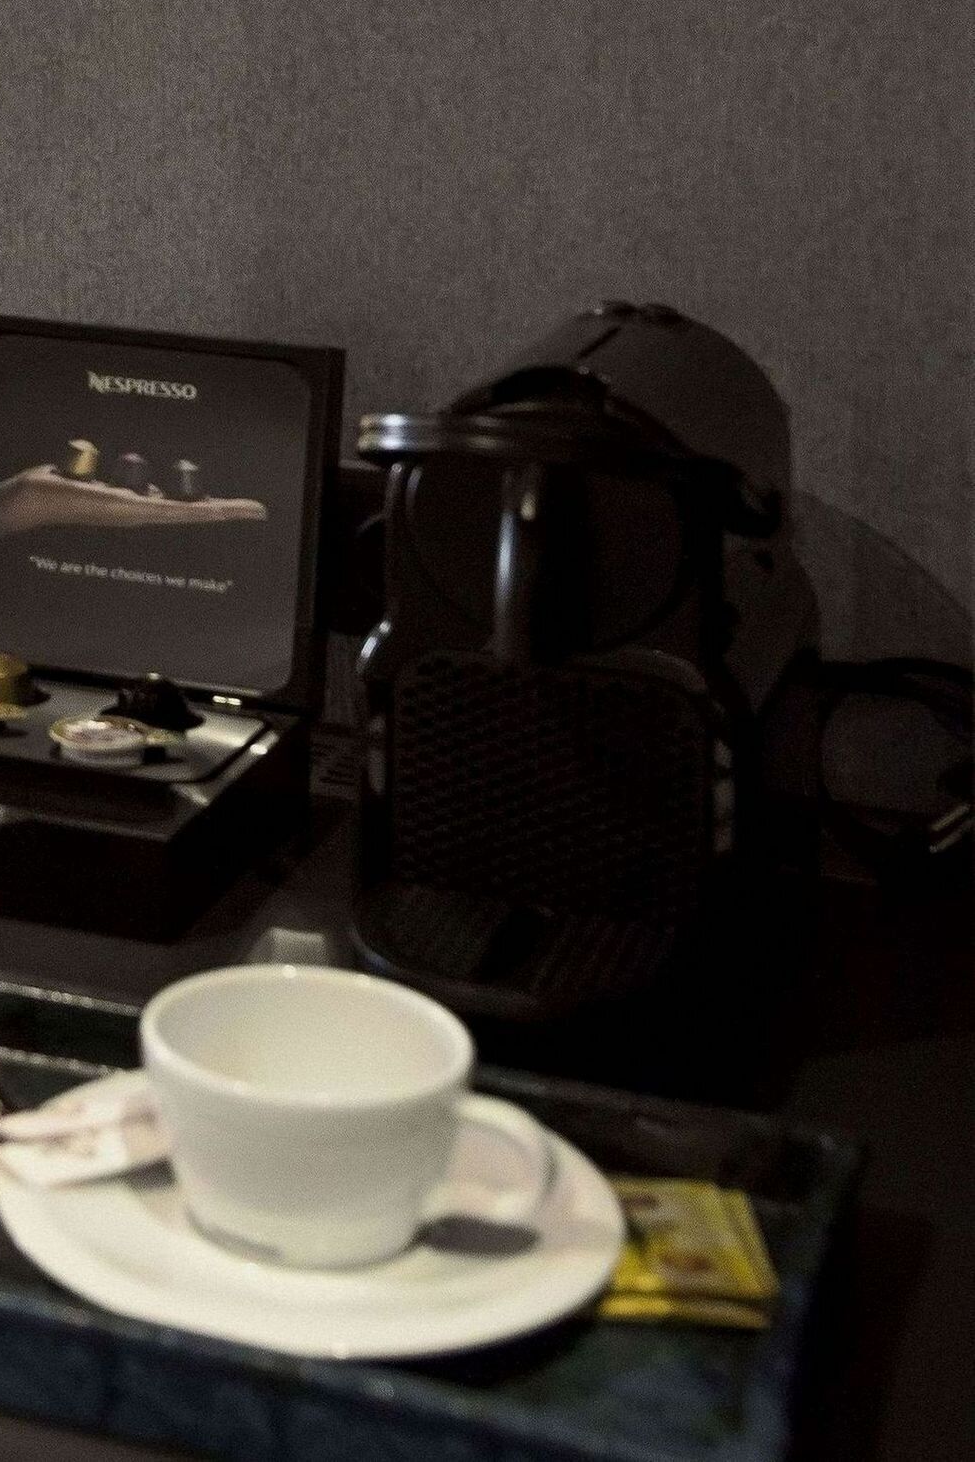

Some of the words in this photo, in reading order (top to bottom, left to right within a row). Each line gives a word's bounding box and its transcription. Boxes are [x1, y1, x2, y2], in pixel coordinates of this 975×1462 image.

[87, 370, 197, 400] NESPRESSO
[60, 561, 82, 575] are
[85, 563, 108, 578] the
[110, 567, 162, 585] choices
[165, 575, 186, 587] we
